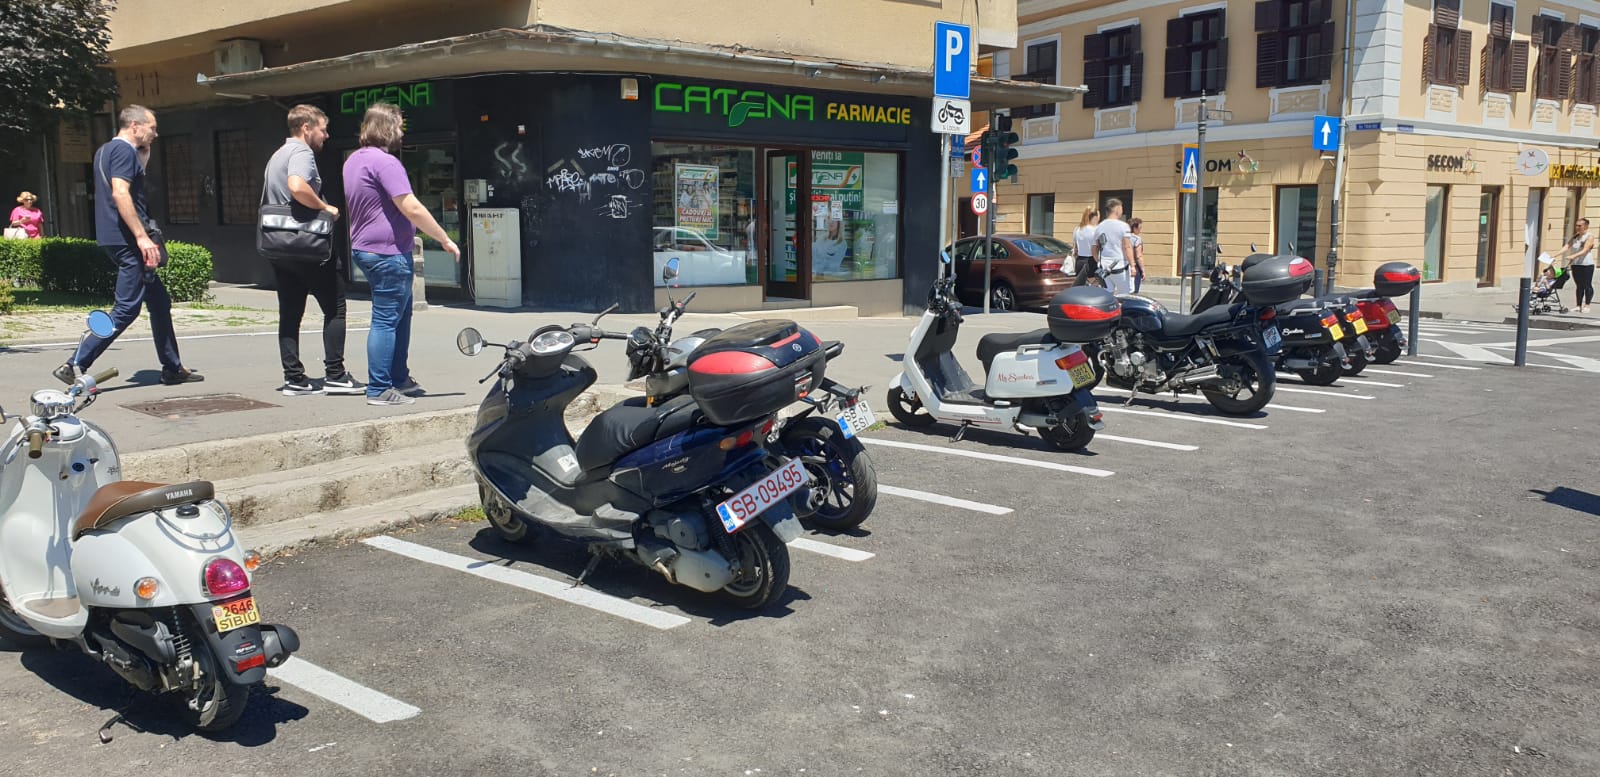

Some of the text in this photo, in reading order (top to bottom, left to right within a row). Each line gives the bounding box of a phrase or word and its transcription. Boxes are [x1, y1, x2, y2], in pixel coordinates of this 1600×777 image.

[945, 29, 963, 72] P
[340, 82, 430, 113] CATENA
[655, 83, 911, 125] CATENA FARMACIE
[1175, 158, 1232, 173] SOM
[1427, 154, 1464, 169] SECOM
[975, 198, 986, 209] 30
[843, 407, 857, 421] SB
[852, 415, 869, 432] ESI
[165, 488, 193, 500] YAMAHA
[223, 599, 254, 617] 2646
[219, 611, 257, 630] SIBIU
